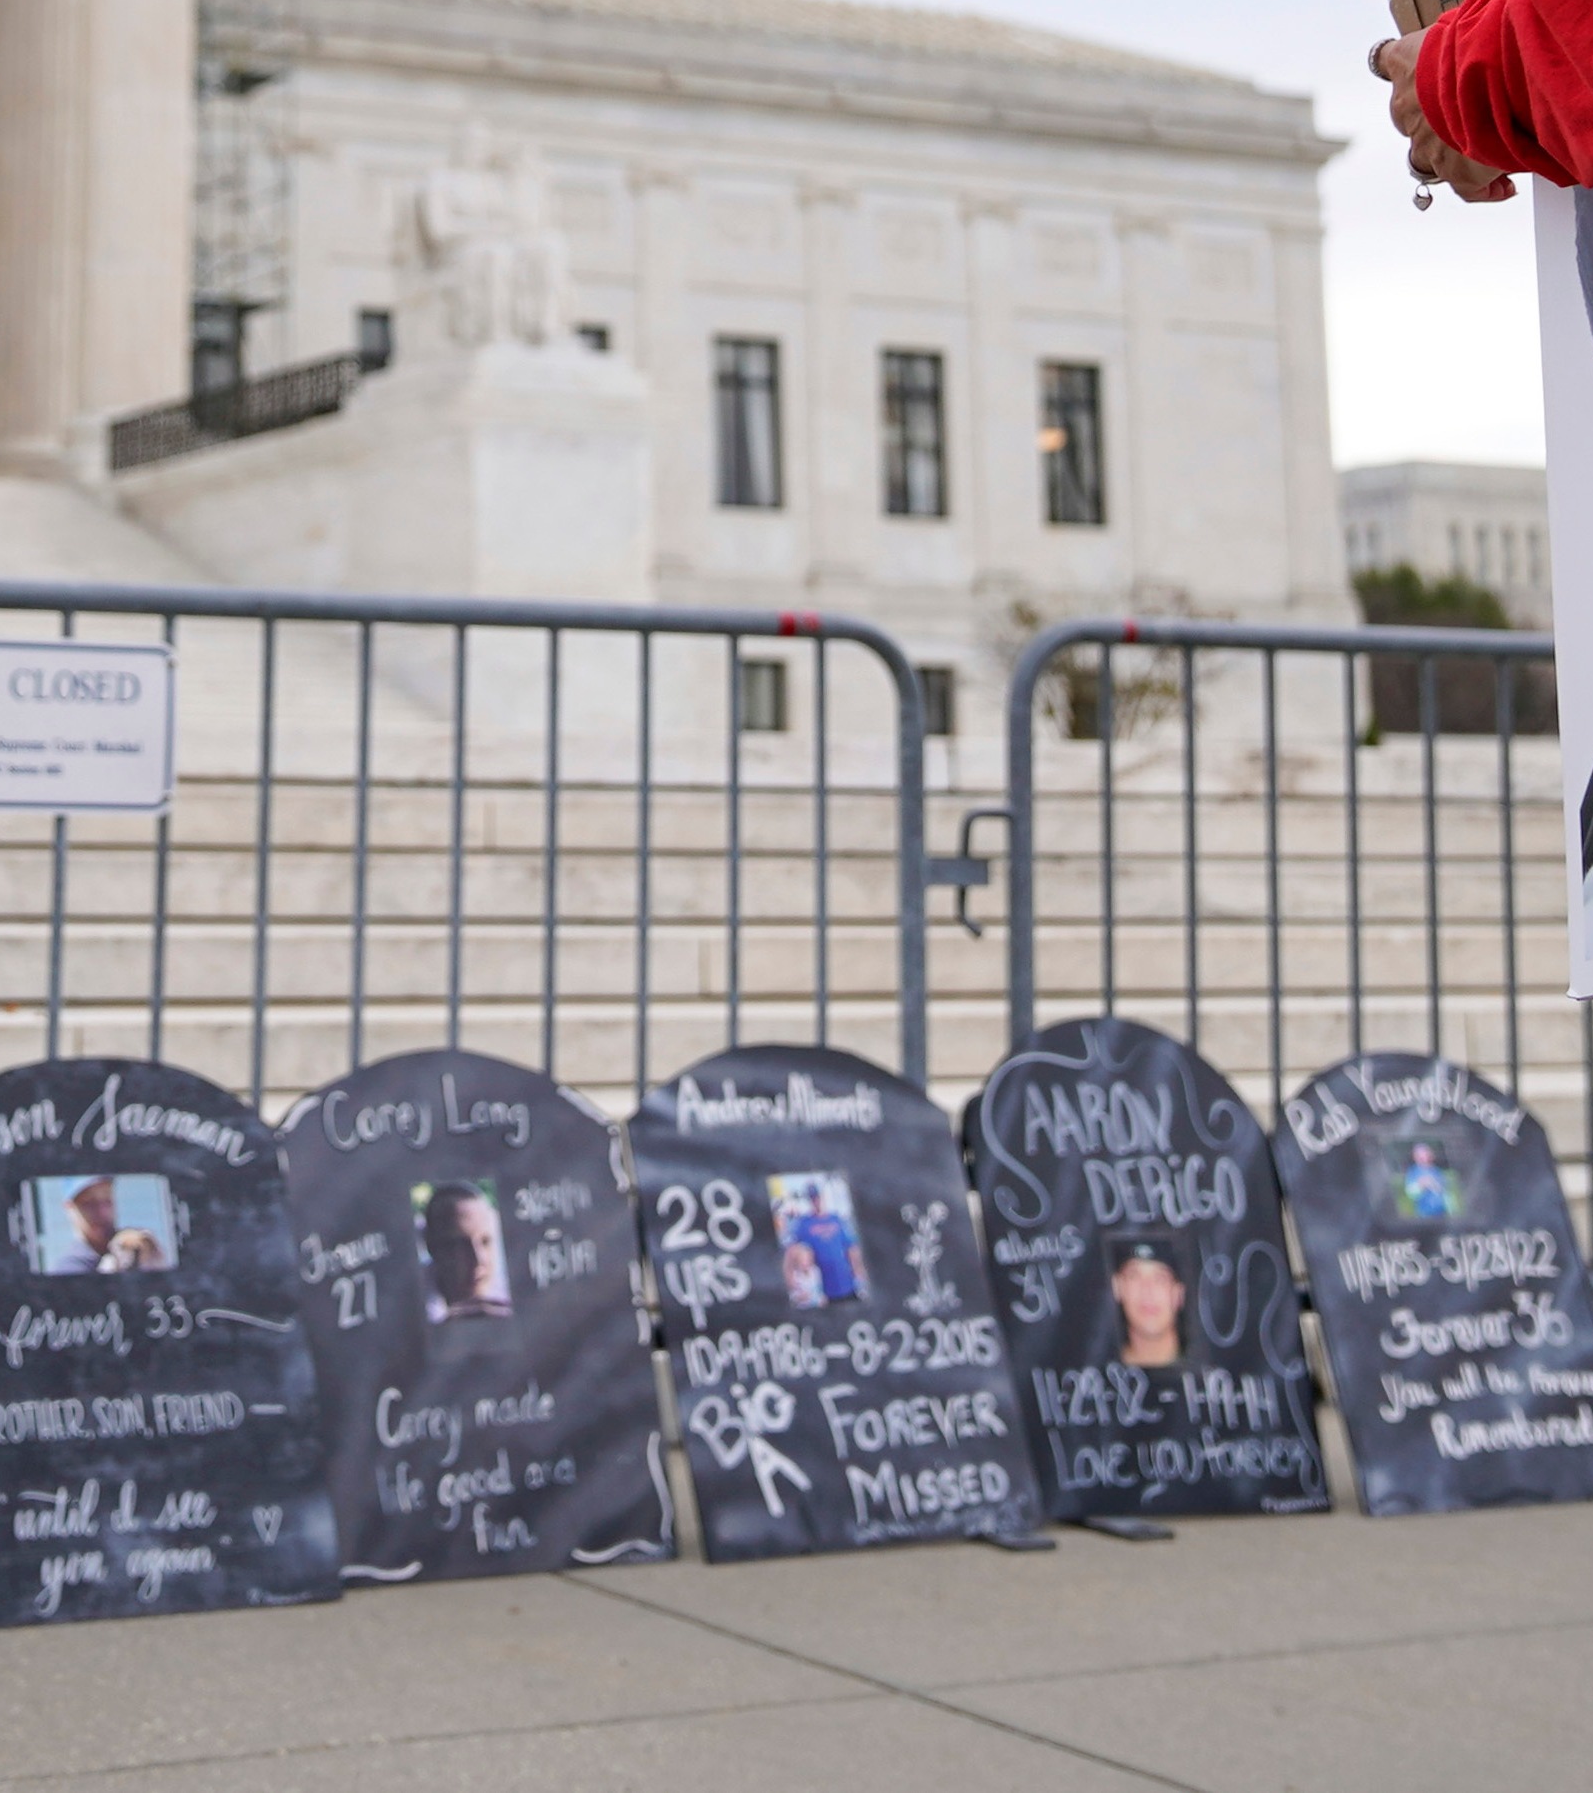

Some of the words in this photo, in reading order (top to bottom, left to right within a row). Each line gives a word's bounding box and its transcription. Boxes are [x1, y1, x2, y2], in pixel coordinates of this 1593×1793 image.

[7, 667, 142, 703] CLOSED
[322, 1089, 432, 1151] Corey
[1025, 1080, 1172, 1157] AARON
[1284, 1081, 1360, 1162] Rob
[1343, 1058, 1526, 1146] Youngblood
[656, 1179, 752, 1252] 28
[144, 1294, 194, 1339] 33
[331, 1270, 379, 1330] 27
[1009, 1264, 1061, 1324] 31
[1511, 1290, 1574, 1350] 36
[153, 1390, 244, 1437] FRIEND
[375, 1387, 463, 1467] Corey
[475, 1377, 555, 1427] made
[819, 1384, 1007, 1459] FOREVER
[13, 1478, 100, 1541] until
[151, 1490, 218, 1532] see
[434, 1447, 515, 1531] good
[846, 1460, 1008, 1524] MISSED
[33, 1550, 108, 1616] you
